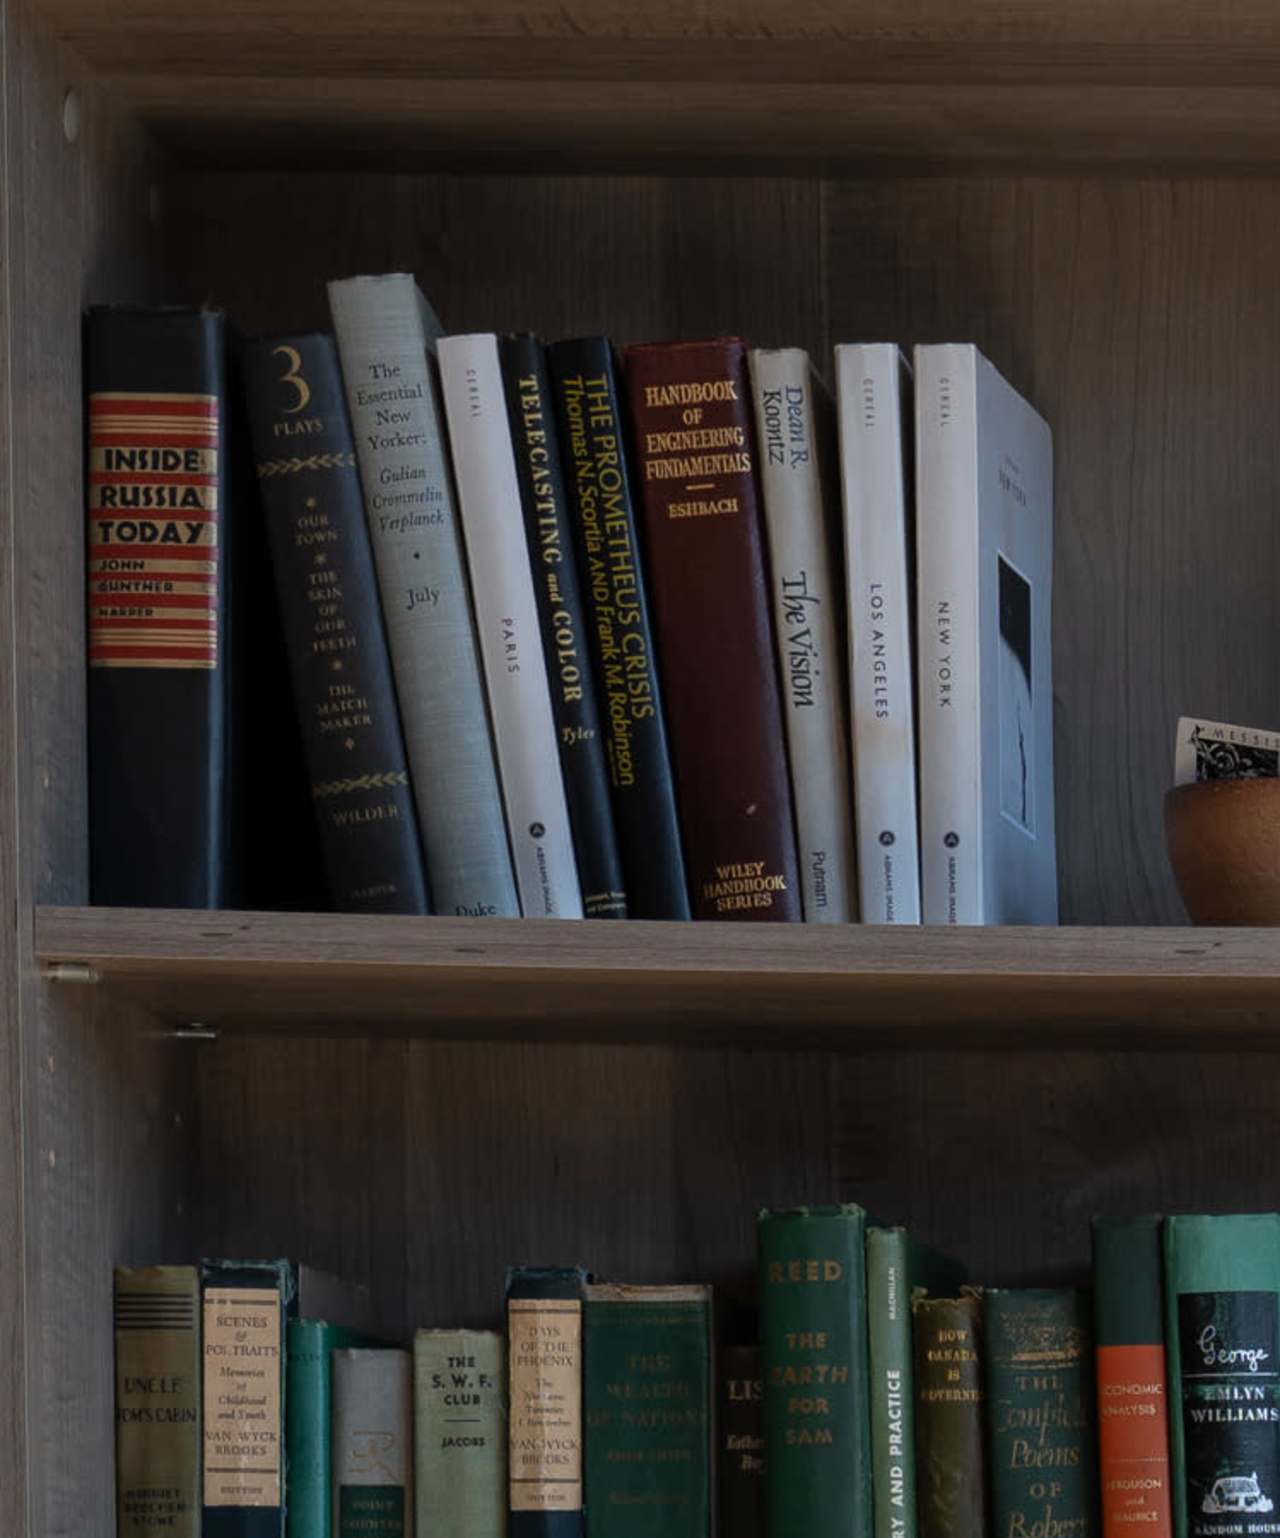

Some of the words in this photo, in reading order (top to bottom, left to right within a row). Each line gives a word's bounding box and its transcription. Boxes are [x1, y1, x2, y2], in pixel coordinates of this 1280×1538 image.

[272, 345, 311, 413] 3
[369, 365, 402, 379] The
[356, 385, 424, 405] Essential
[586, 372, 613, 428] THE
[644, 381, 738, 407] HANDBOOK
[376, 410, 412, 425] New
[563, 374, 587, 457] Thomas
[682, 408, 703, 424] OF
[785, 386, 803, 442] Dean
[273, 419, 324, 437] PLAYS
[763, 389, 784, 465] Koontz
[646, 427, 744, 453] ENGINEERING
[103, 449, 199, 472] INSIDE
[518, 374, 562, 565] TELECASTING
[645, 453, 751, 480] FUNDAMENTALS
[380, 466, 427, 484] Gulian
[100, 486, 203, 508] RUSSIA
[579, 486, 601, 553] Scortia
[668, 499, 738, 519] ESHBACH
[98, 521, 204, 544] TODAY
[593, 433, 641, 626] PROMETHEUS
[99, 560, 145, 570] JOHN
[546, 572, 563, 603] and
[589, 557, 609, 601] AND
[407, 587, 441, 609] July
[782, 570, 820, 625] The
[869, 583, 884, 620] LOS
[596, 605, 617, 661] Frank
[937, 602, 950, 645] NEW
[501, 618, 520, 674] PARIS
[553, 611, 583, 702] COLOR
[621, 632, 654, 718] CRISIS
[786, 628, 820, 708] Vision
[871, 631, 889, 720] ANGELES
[939, 655, 951, 708] YORK
[561, 725, 595, 745] Tyler
[608, 691, 634, 786] Robinson
[333, 806, 399, 826] WILDER
[716, 862, 765, 880] WILEY
[810, 850, 828, 908] Putnam
[704, 876, 787, 898] HANDBOOK
[716, 895, 772, 911] SERIES
[768, 1259, 844, 1283] REED
[216, 1316, 267, 1328] SCENES
[784, 1331, 829, 1350] THE
[938, 1328, 968, 1344] HOW
[1197, 1325, 1270, 1372] George
[447, 1357, 476, 1368] THE
[123, 1376, 183, 1394] UNCLE
[771, 1365, 848, 1385] EARTH
[444, 1394, 481, 1405] CLUB
[1203, 1385, 1266, 1400] EMLYN
[155, 1407, 197, 1423] CABIN
[788, 1397, 830, 1415] FOR
[886, 1369, 903, 1458] PRACTICE
[1191, 1408, 1280, 1423] WILLIAMS
[785, 1427, 833, 1446] SAM
[888, 1464, 904, 1508] AND
